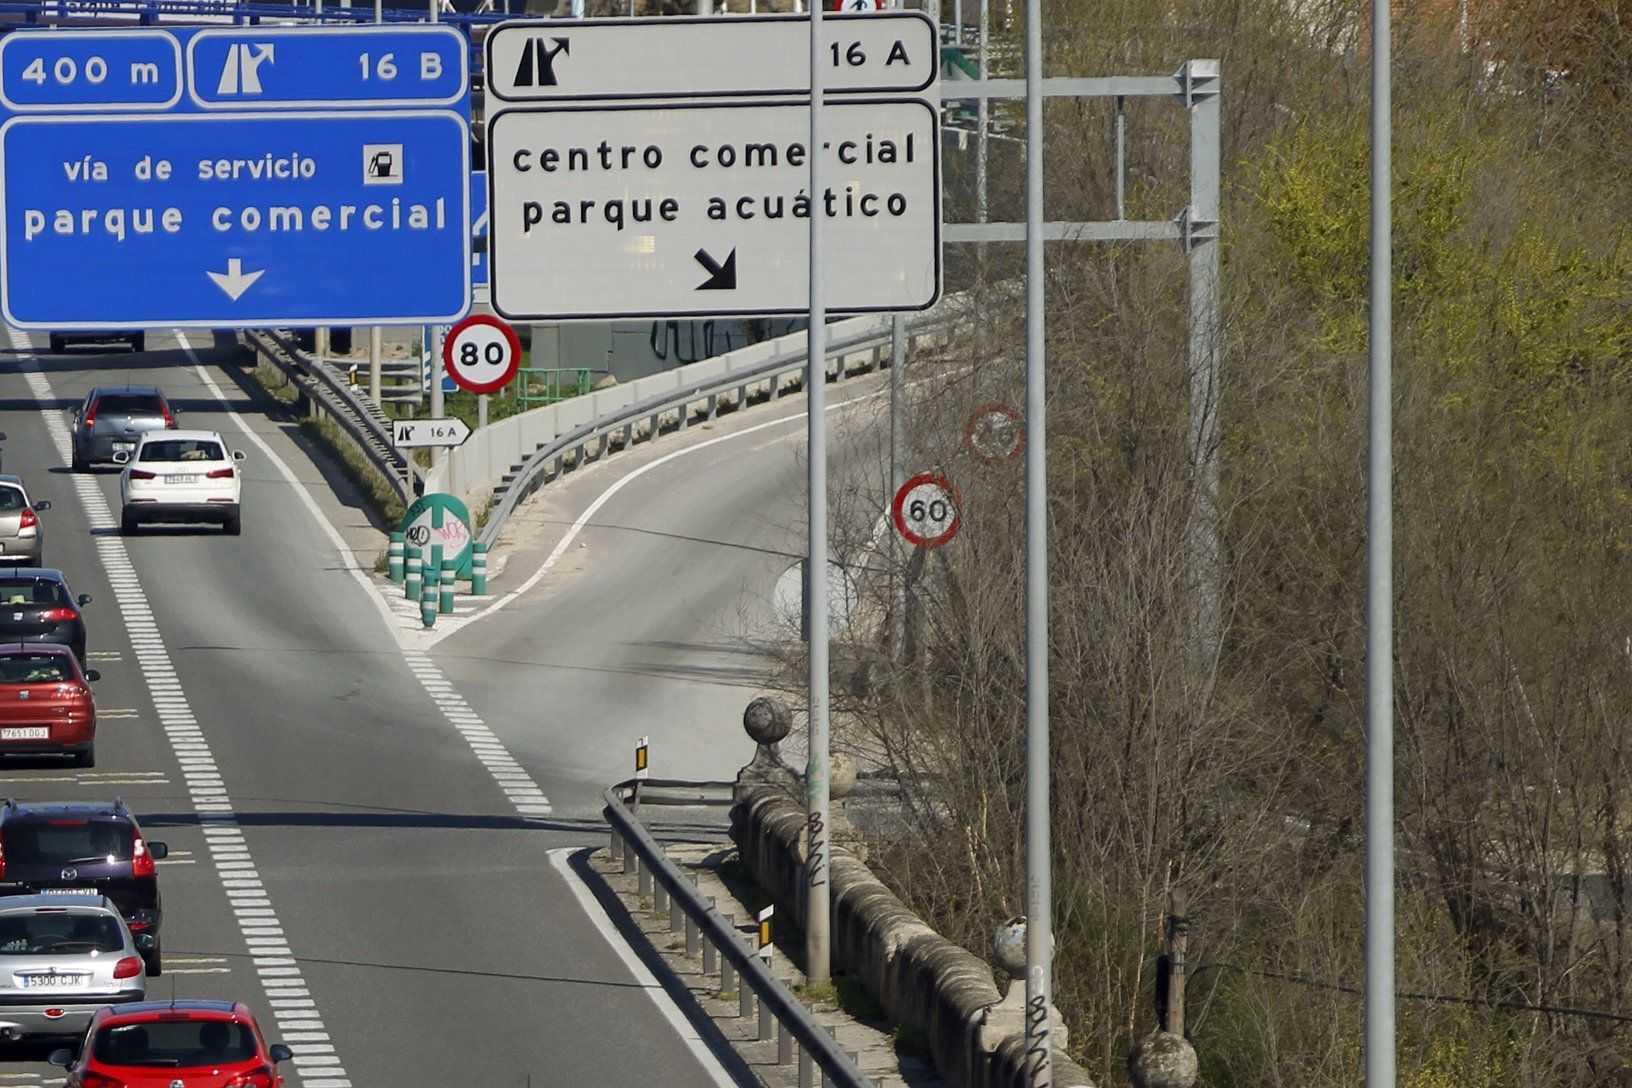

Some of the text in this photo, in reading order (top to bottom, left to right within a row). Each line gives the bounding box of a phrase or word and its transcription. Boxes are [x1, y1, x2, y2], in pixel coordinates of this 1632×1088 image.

[360, 53, 443, 80] 16 B
[831, 40, 911, 67] 16 A
[23, 57, 158, 84] 400 m
[513, 132, 914, 172] centro comecial
[64, 152, 316, 181] vía de servicio
[25, 197, 445, 241] parque comercial
[524, 188, 908, 232] parque acuático
[460, 342, 504, 366] 80
[431, 427, 457, 437] 16 A
[910, 500, 947, 522] 60
